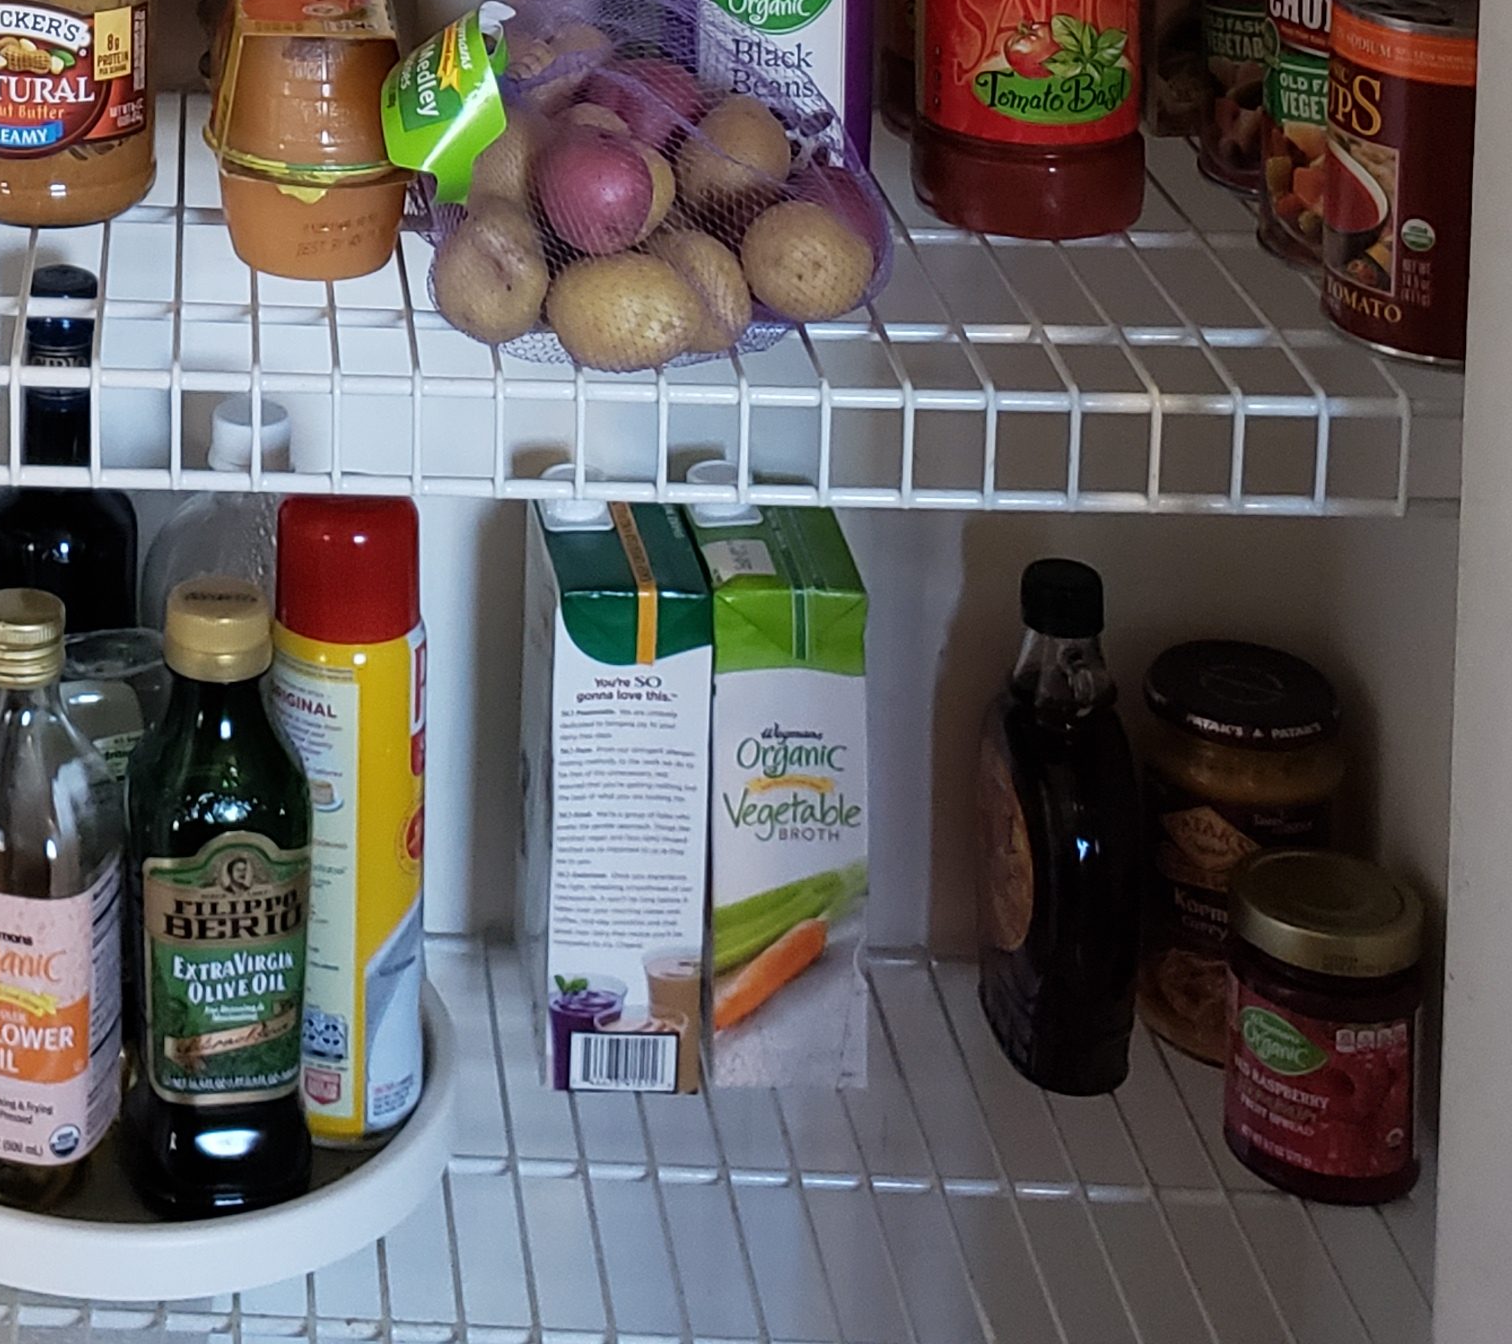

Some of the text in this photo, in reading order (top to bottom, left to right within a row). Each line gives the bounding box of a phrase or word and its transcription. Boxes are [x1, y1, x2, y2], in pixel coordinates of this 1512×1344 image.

[731, 38, 813, 69] Black
[730, 69, 810, 98] Beans
[975, 69, 1126, 113] Tomato Basil
[737, 737, 847, 779] Organic
[722, 790, 862, 842] Vegetable
[778, 828, 840, 842] BROTH
[174, 889, 297, 916] FILIPPO
[163, 902, 301, 941] BERIO
[173, 951, 294, 982] EXTRA VIRGIN
[188, 971, 286, 1005] OLIVE OIL
